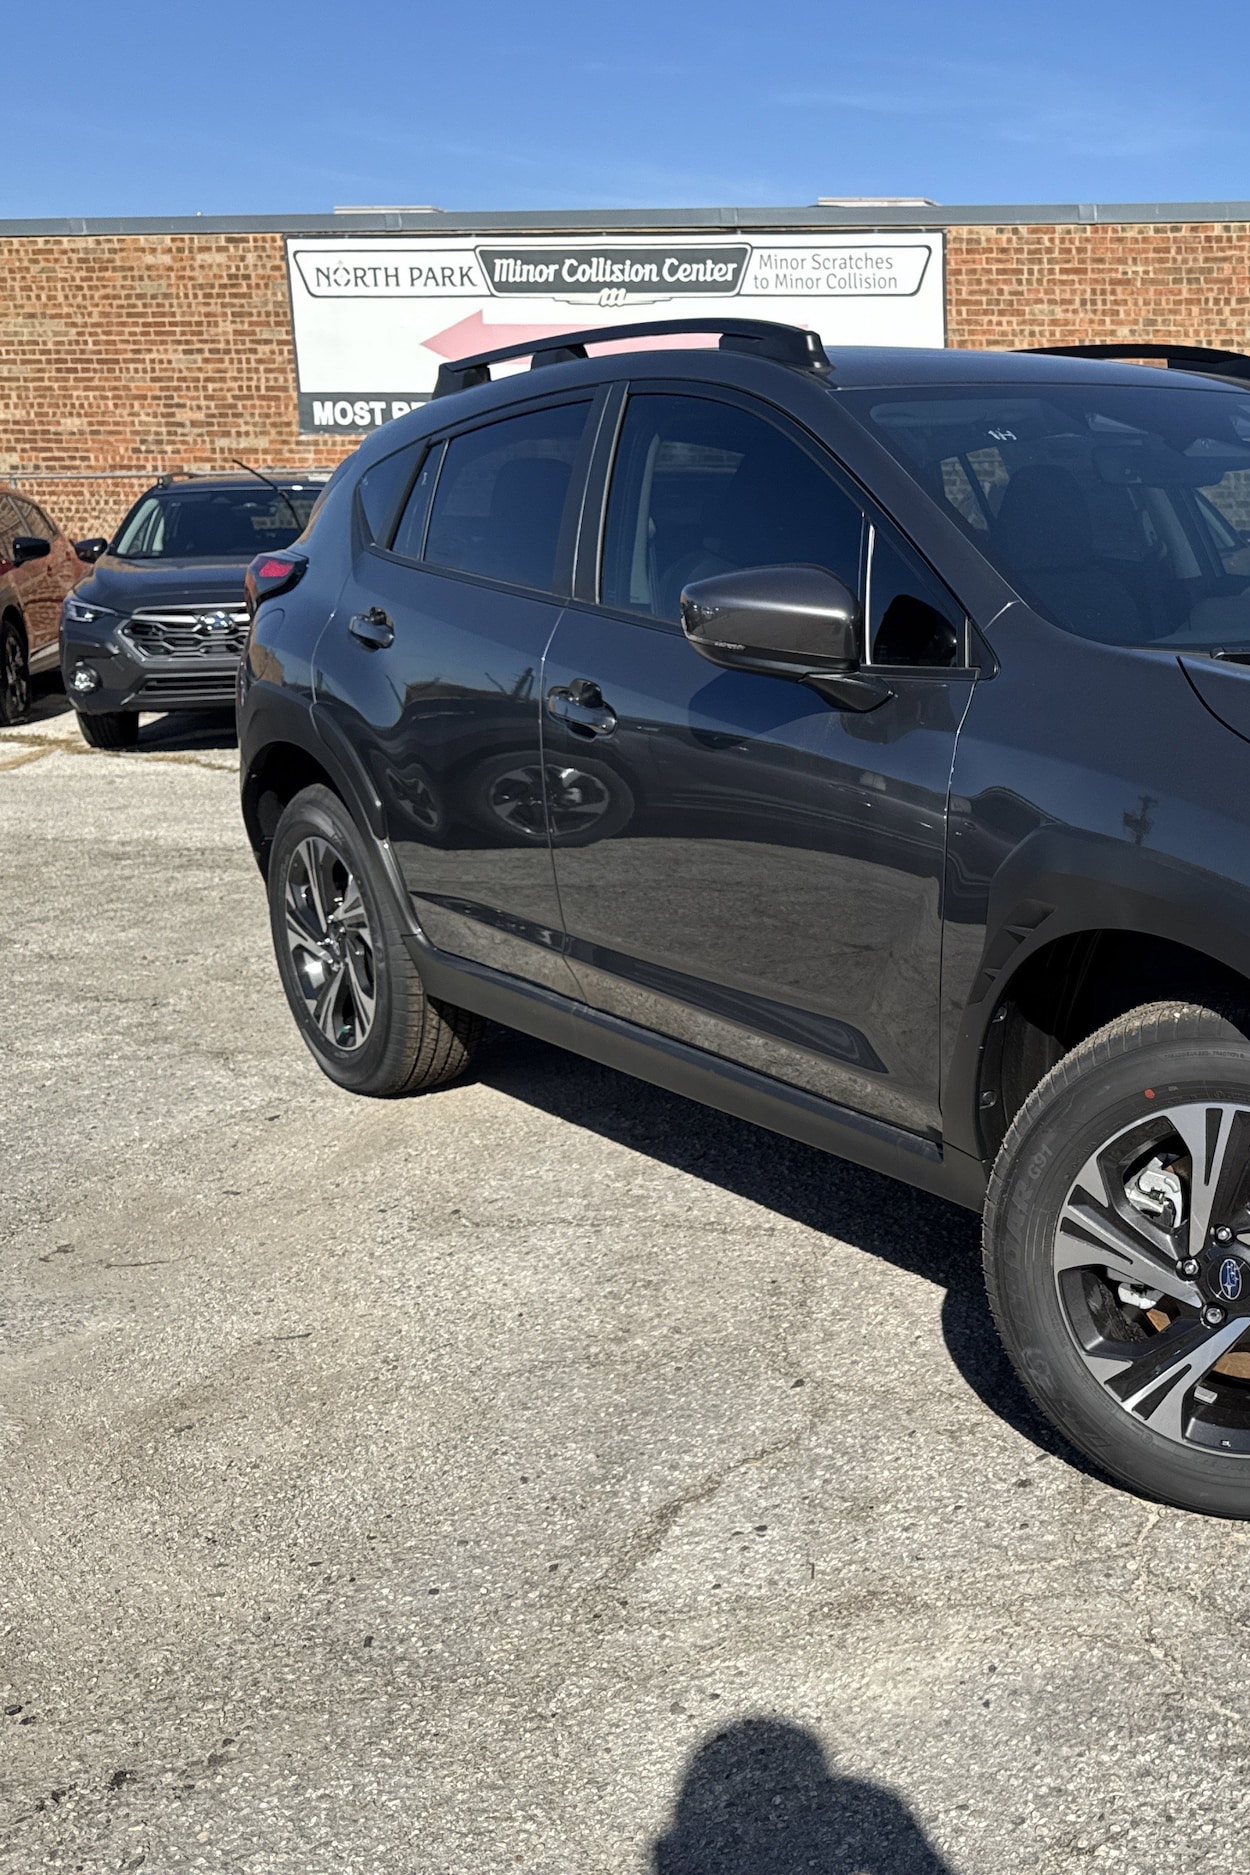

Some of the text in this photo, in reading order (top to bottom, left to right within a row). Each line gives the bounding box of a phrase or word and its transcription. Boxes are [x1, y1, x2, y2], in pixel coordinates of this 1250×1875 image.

[494, 257, 738, 282] Minor Collision Center
[759, 252, 893, 270] Minor Scratches
[316, 266, 478, 288] NORTH PARK
[754, 272, 897, 290] to Minor Collision
[312, 400, 386, 426] MOST
[1027, 1143, 1053, 1181] G91
